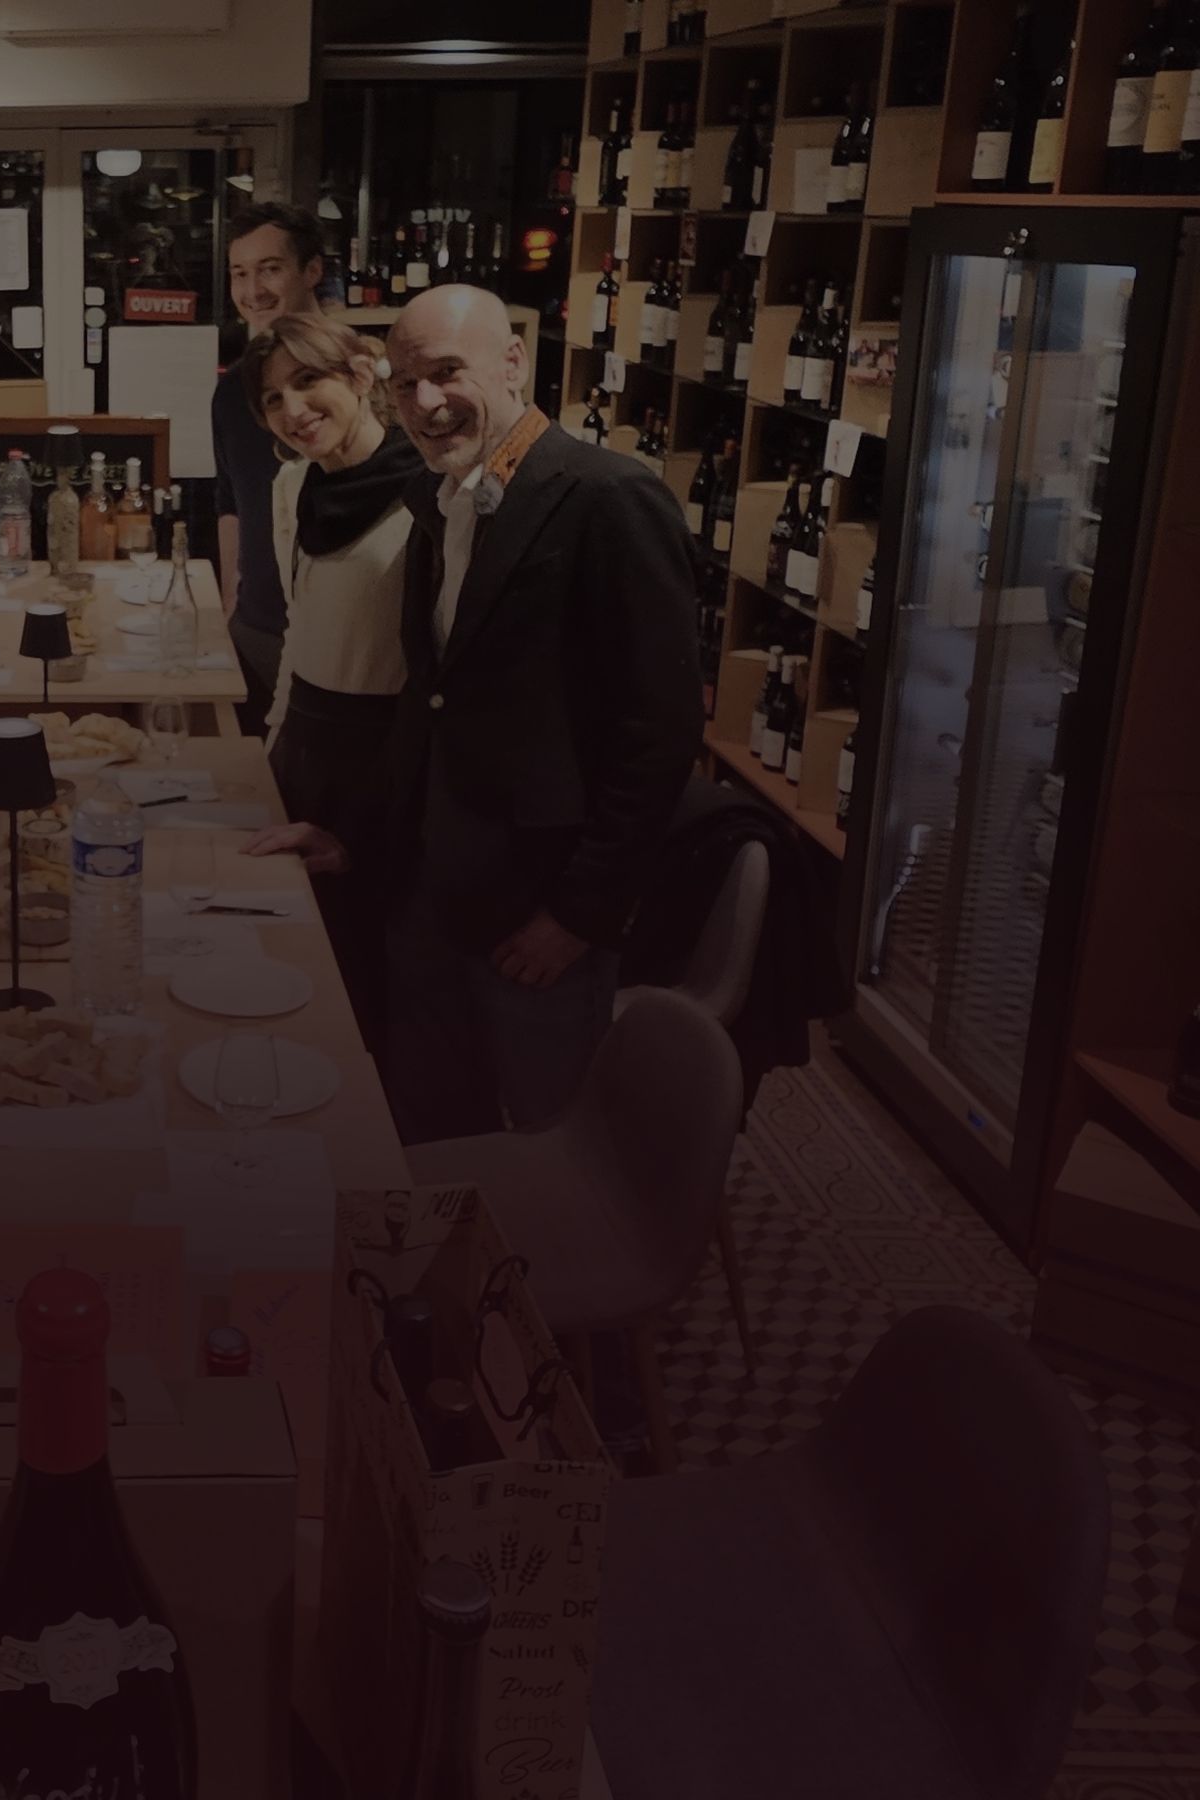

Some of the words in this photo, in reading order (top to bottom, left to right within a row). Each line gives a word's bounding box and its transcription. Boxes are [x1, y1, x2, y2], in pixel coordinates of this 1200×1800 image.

[129, 295, 192, 314] OUVERT
[503, 1482, 552, 1500] Beer
[497, 1676, 565, 1700] Prost
[494, 1706, 567, 1731] drink
